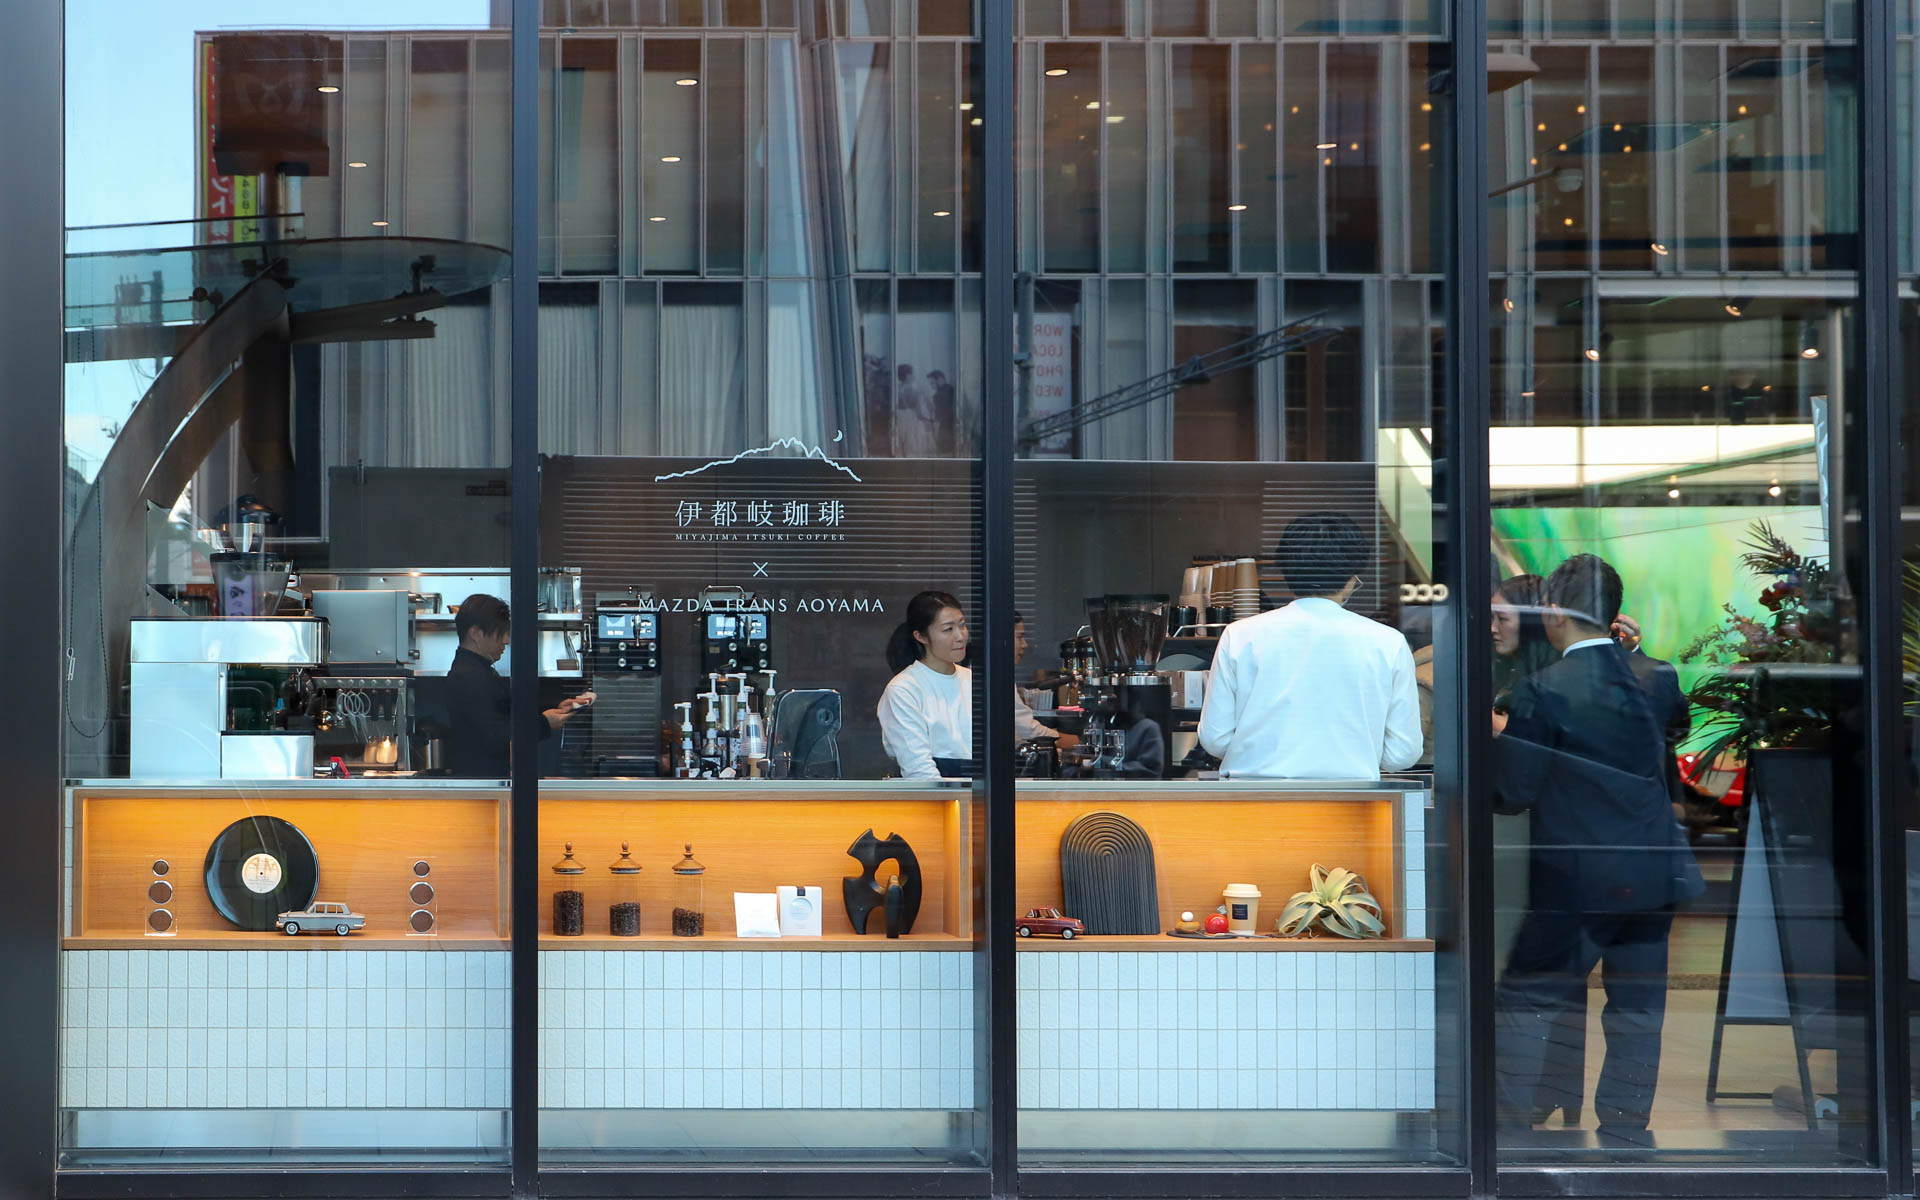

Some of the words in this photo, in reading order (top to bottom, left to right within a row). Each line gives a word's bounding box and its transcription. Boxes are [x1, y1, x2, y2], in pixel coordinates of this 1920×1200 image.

[675, 500, 845, 527] 伊都岐珈琲
[675, 533, 739, 542] MIYAJIMA
[746, 533, 790, 541] ITSUKI
[798, 533, 846, 541] COFFEE
[638, 598, 714, 612] MAZDA
[724, 598, 787, 612] TRANS
[796, 598, 885, 612] AOYAMA
